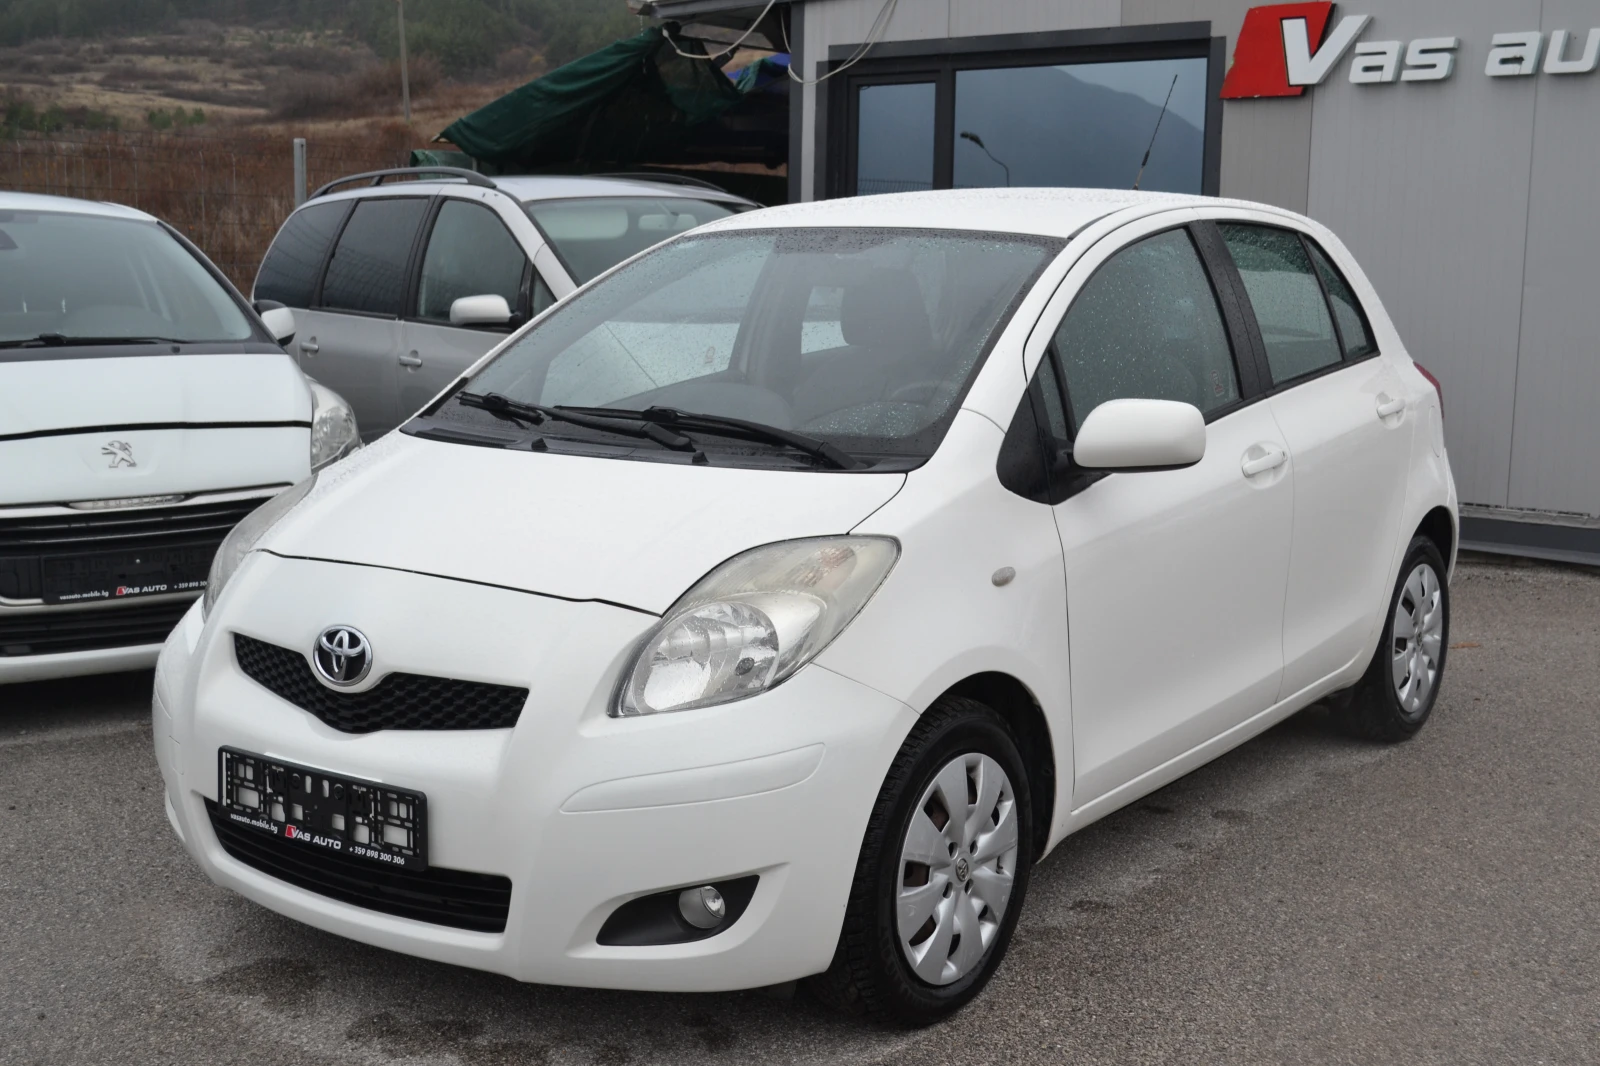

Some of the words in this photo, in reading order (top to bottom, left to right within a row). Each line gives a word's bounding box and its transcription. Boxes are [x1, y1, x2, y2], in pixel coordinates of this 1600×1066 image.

[1280, 14, 1461, 86] Vas
[121, 585, 140, 595] VAS
[142, 584, 168, 593] AUTO
[230, 813, 278, 834] vasauto.mobile.bg
[290, 828, 311, 841] VAS
[313, 835, 342, 850] AUTO
[366, 849, 379, 859] 898
[379, 852, 392, 862] 300
[392, 855, 405, 865] 306
